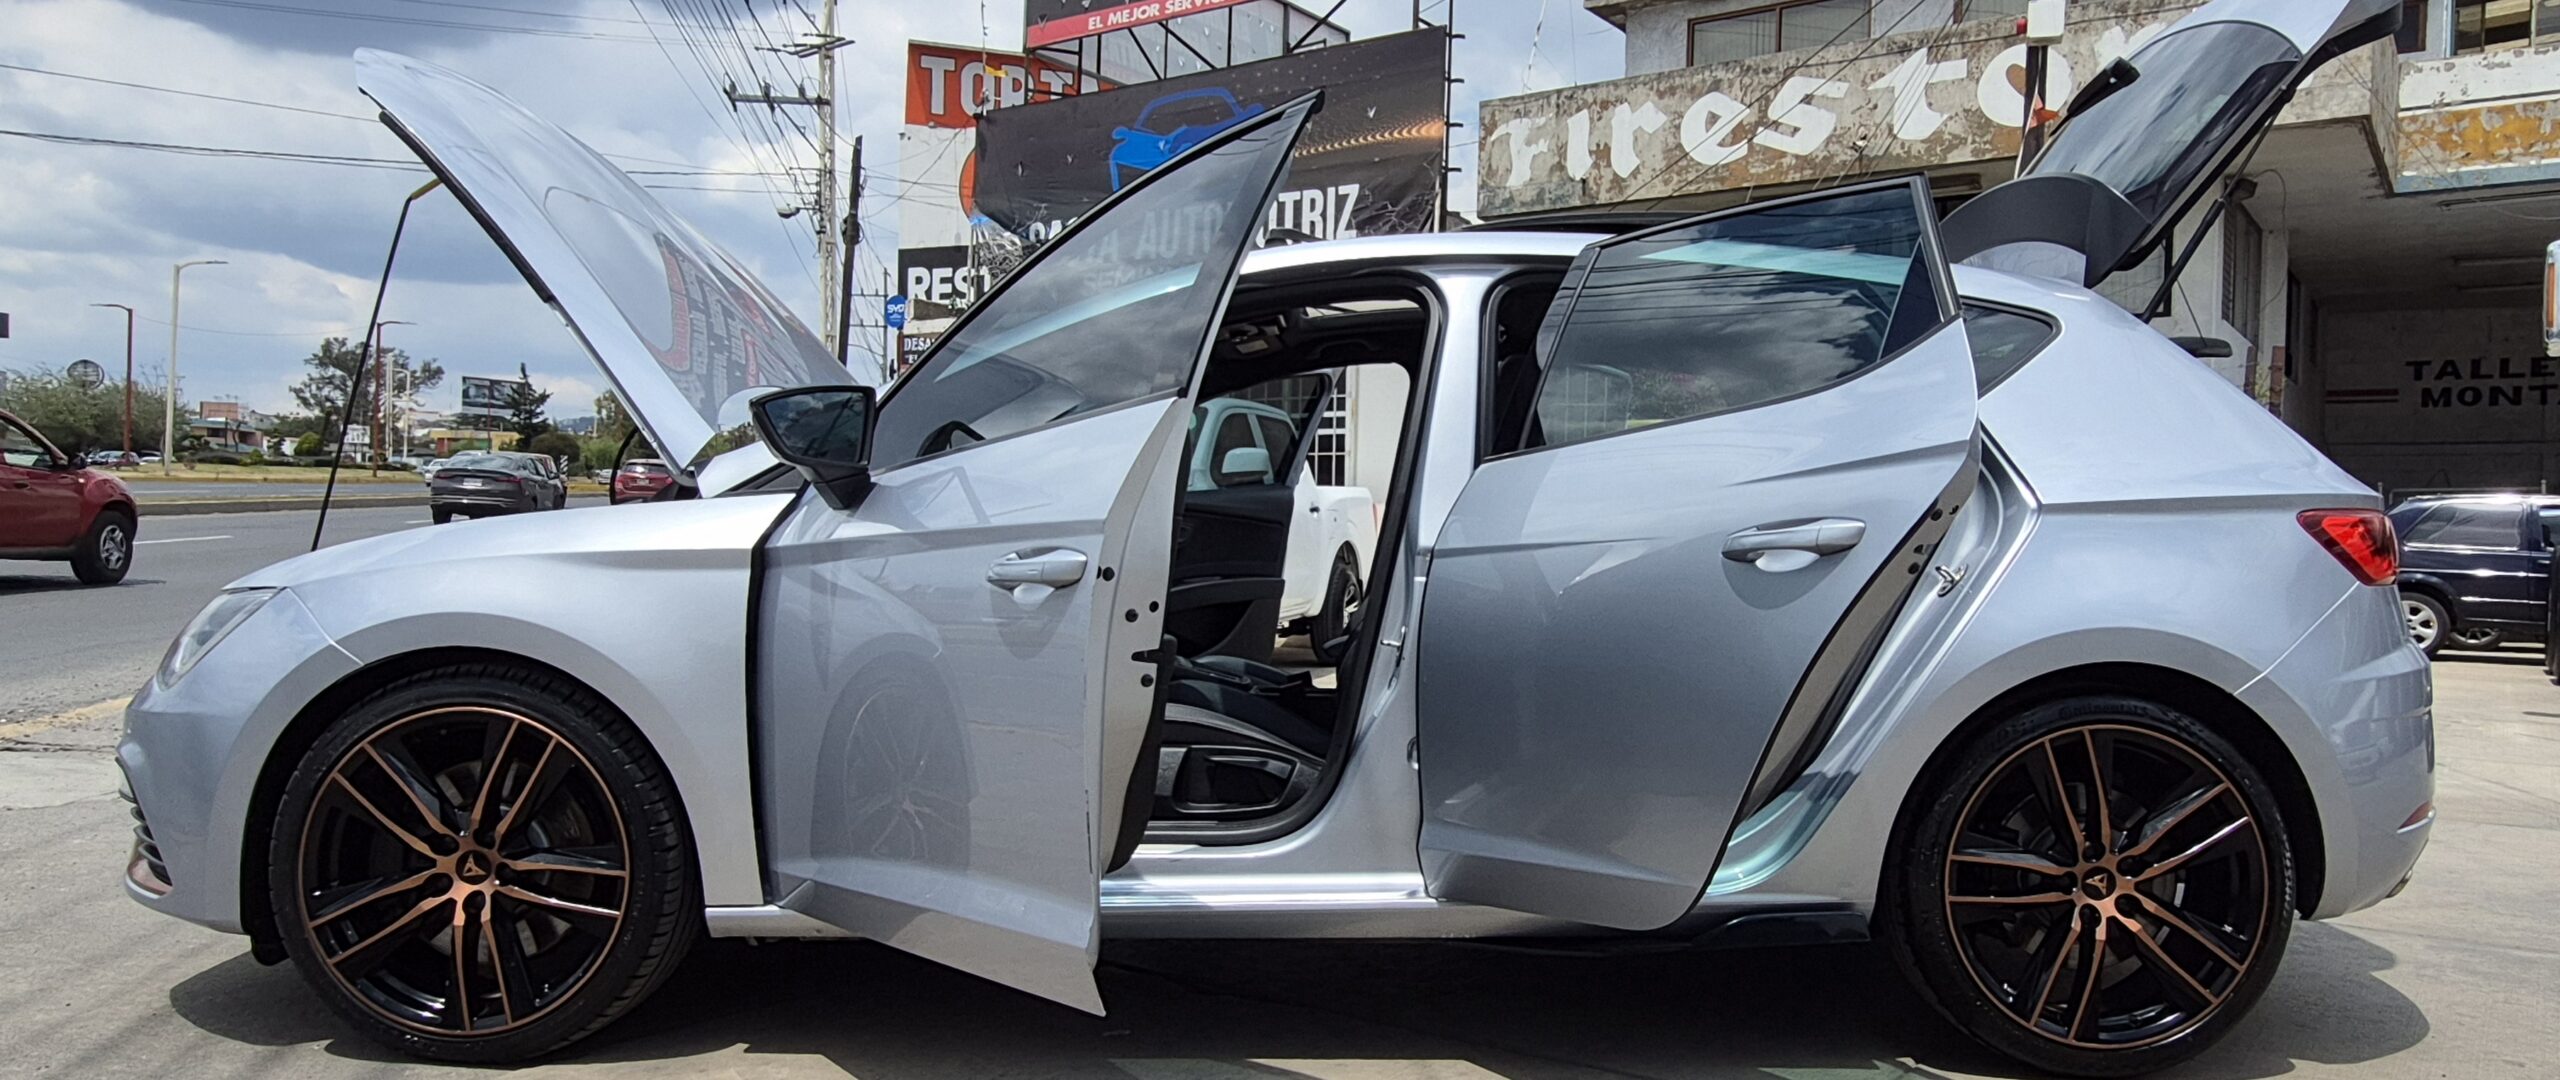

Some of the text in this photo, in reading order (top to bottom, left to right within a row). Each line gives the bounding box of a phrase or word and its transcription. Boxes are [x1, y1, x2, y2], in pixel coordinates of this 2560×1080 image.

[1087, 16, 1104, 30] EL
[1107, 4, 1160, 27] MEJOR
[904, 337, 936, 352] DESA
[2421, 384, 2560, 408] MONT
